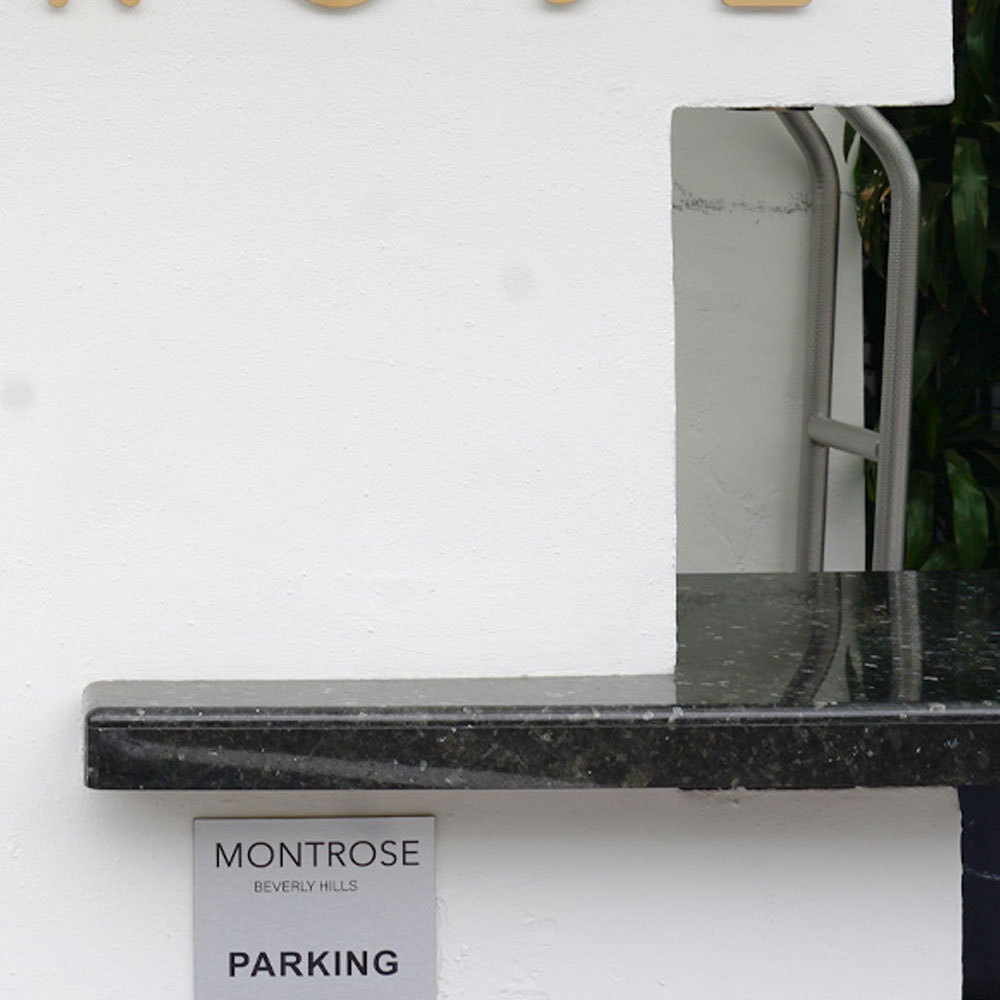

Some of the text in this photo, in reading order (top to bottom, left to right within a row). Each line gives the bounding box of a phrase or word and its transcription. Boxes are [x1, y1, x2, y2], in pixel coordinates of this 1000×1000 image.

[215, 840, 420, 868] MONTROSE
[253, 879, 359, 893] BEVERLY HILLS
[228, 950, 399, 977] PARKING
